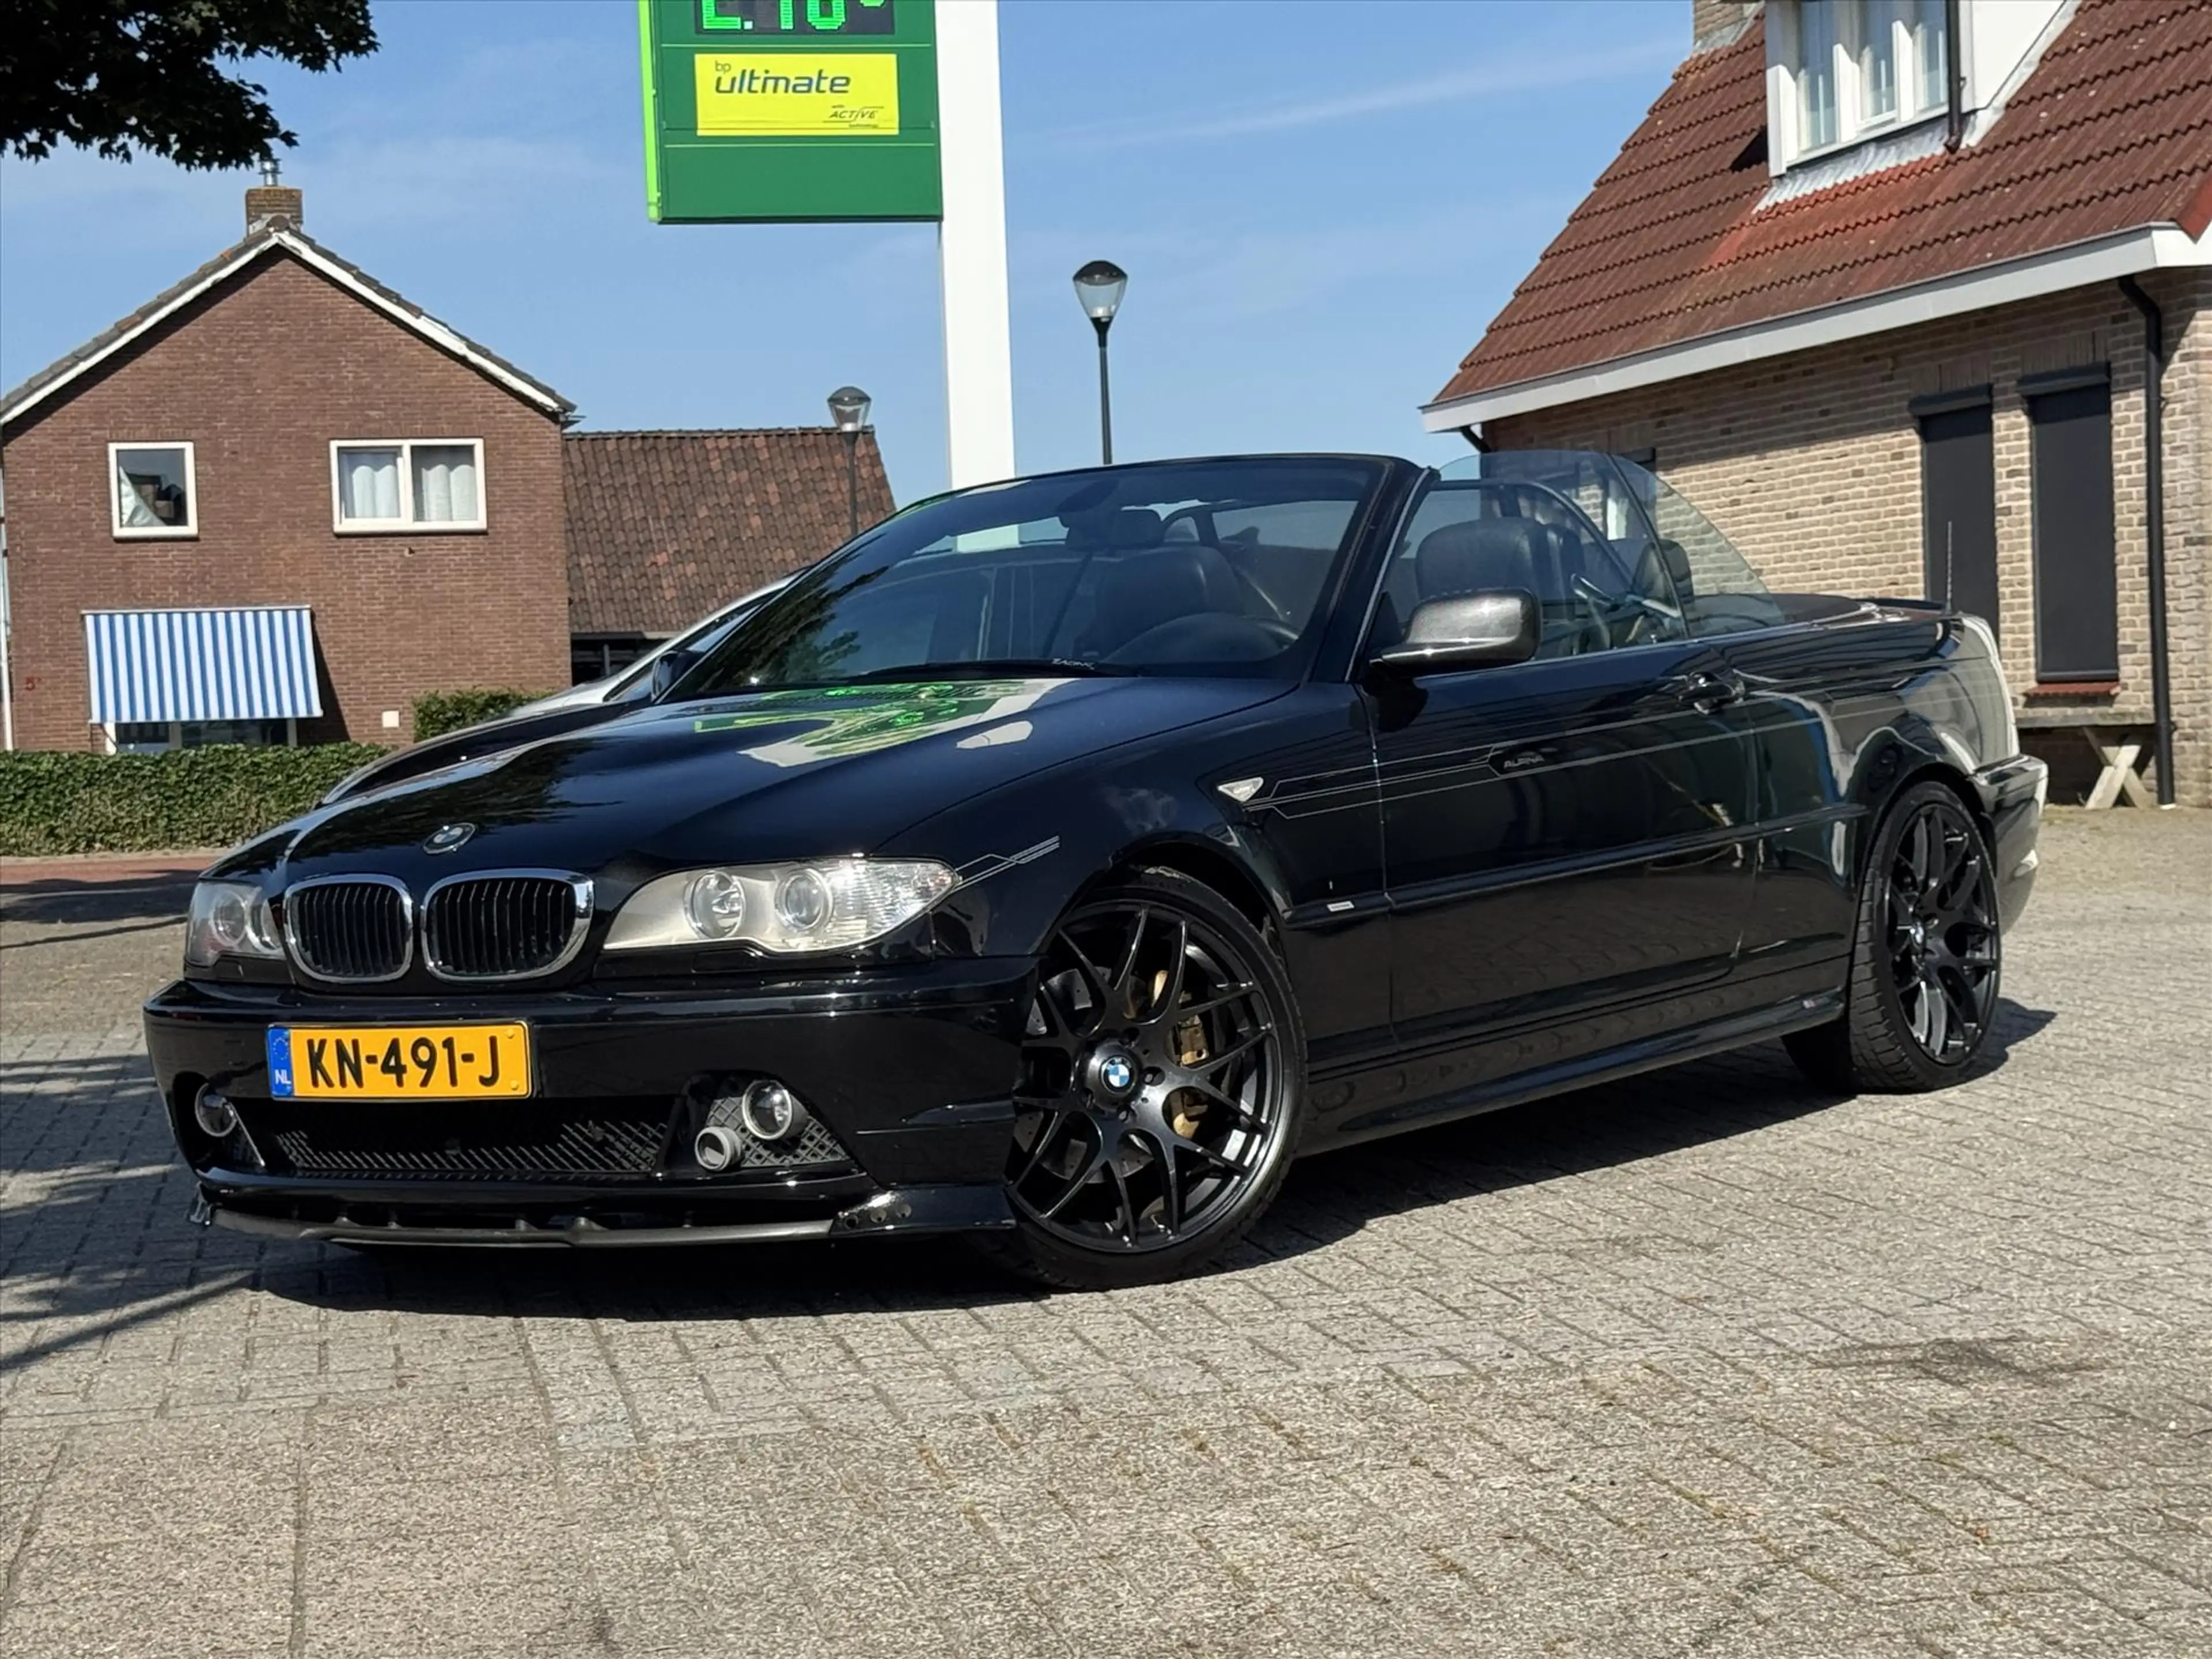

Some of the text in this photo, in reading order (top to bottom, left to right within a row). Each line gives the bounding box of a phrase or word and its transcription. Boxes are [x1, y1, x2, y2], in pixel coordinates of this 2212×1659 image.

[715, 60, 731, 74] bp
[715, 69, 851, 94] ultimate
[306, 1035, 501, 1088] KN-491-J
[275, 1069, 291, 1084] NL
